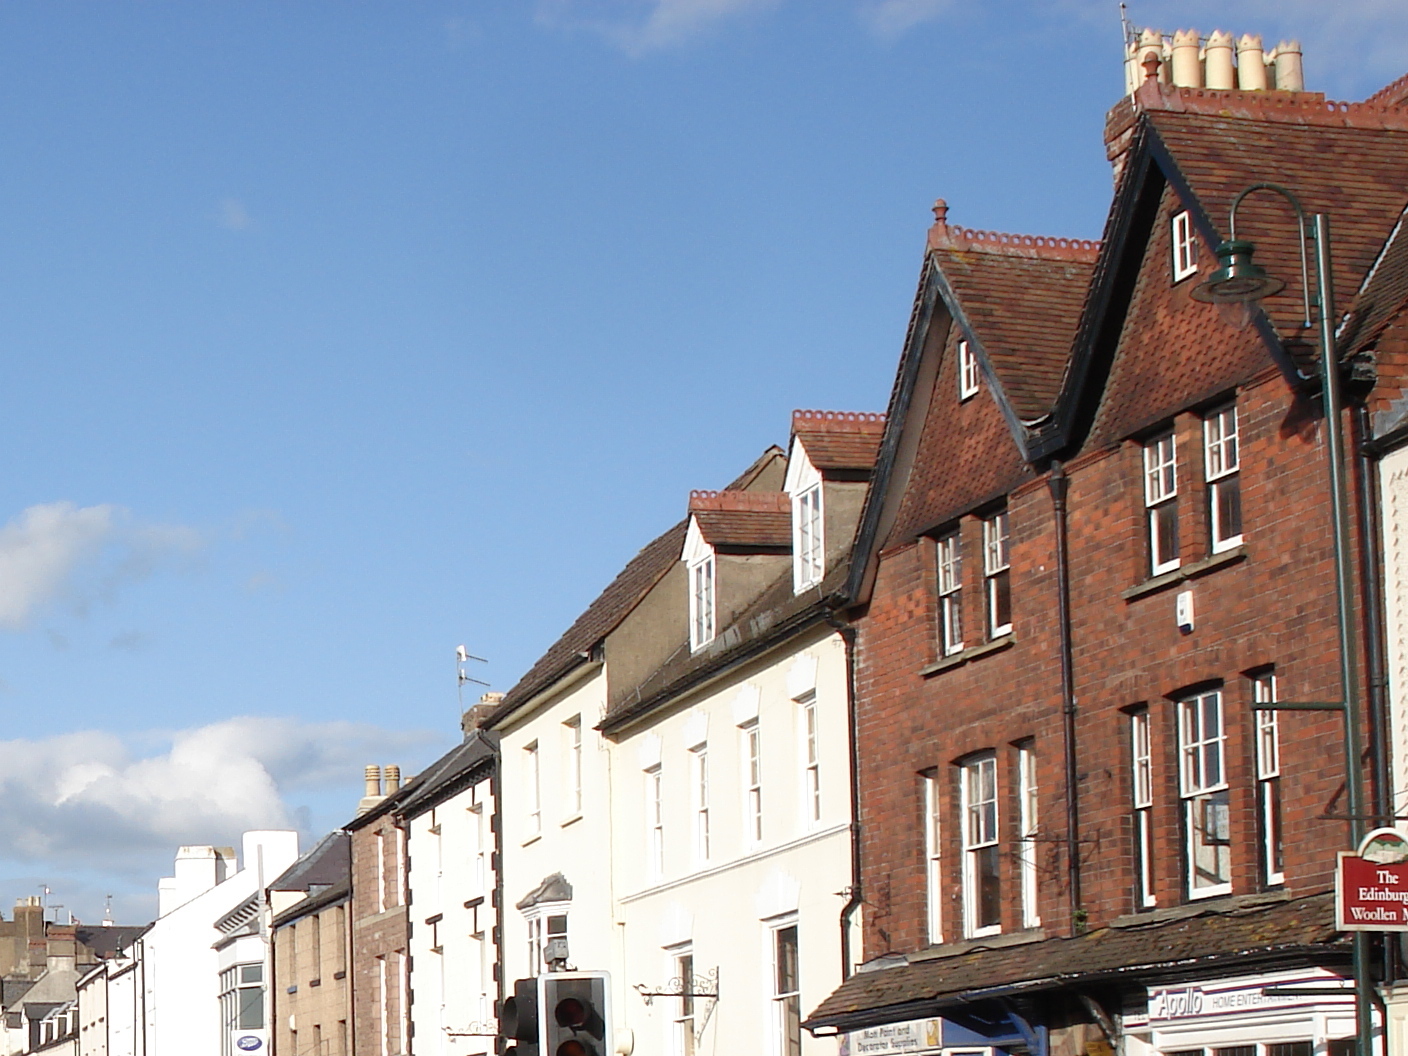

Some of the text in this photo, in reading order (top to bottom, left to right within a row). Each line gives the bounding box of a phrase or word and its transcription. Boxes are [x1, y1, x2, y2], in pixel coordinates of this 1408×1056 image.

[1376, 870, 1399, 884] The
[1358, 887, 1408, 905] Edinburg
[1350, 907, 1397, 921] Woollen
[1158, 988, 1203, 1020] Apollo
